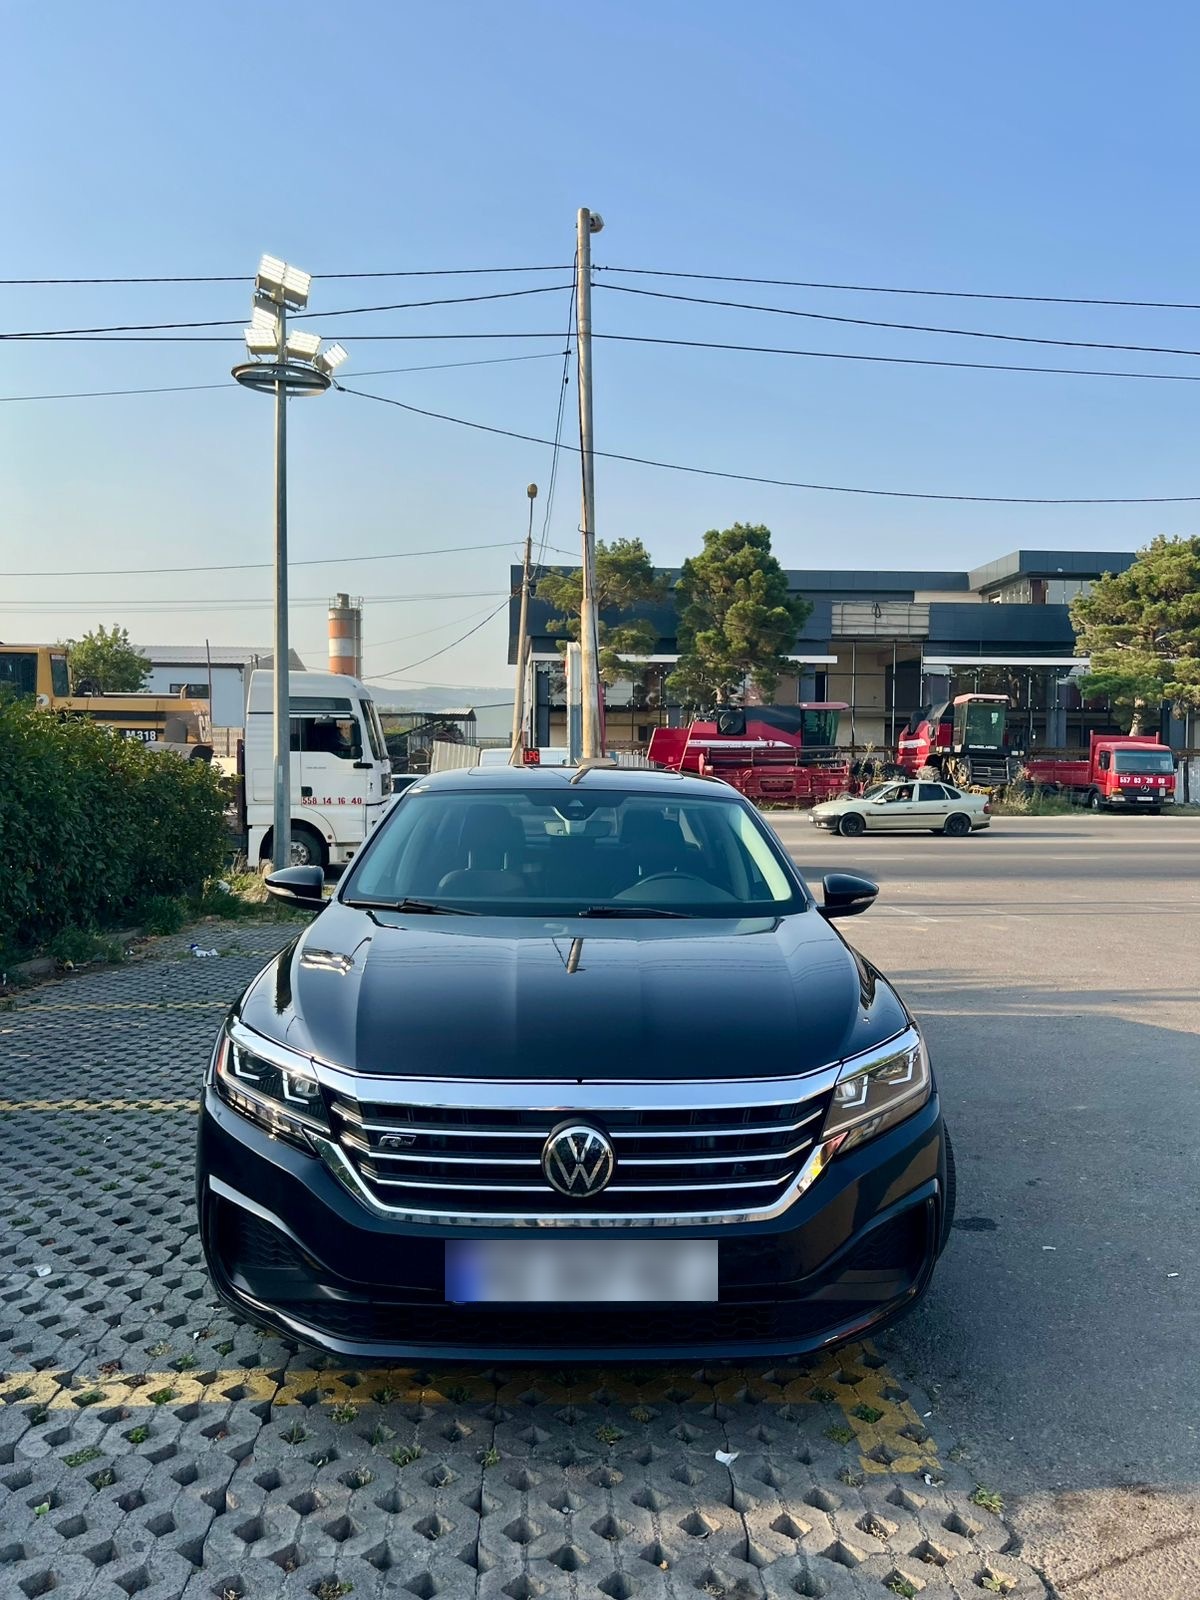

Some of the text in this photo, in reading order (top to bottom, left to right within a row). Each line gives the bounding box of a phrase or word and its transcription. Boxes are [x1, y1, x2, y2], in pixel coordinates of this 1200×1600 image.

[126, 730, 156, 740] M318
[524, 750, 539, 762] LPG
[302, 796, 362, 805] 558 14 16 40
